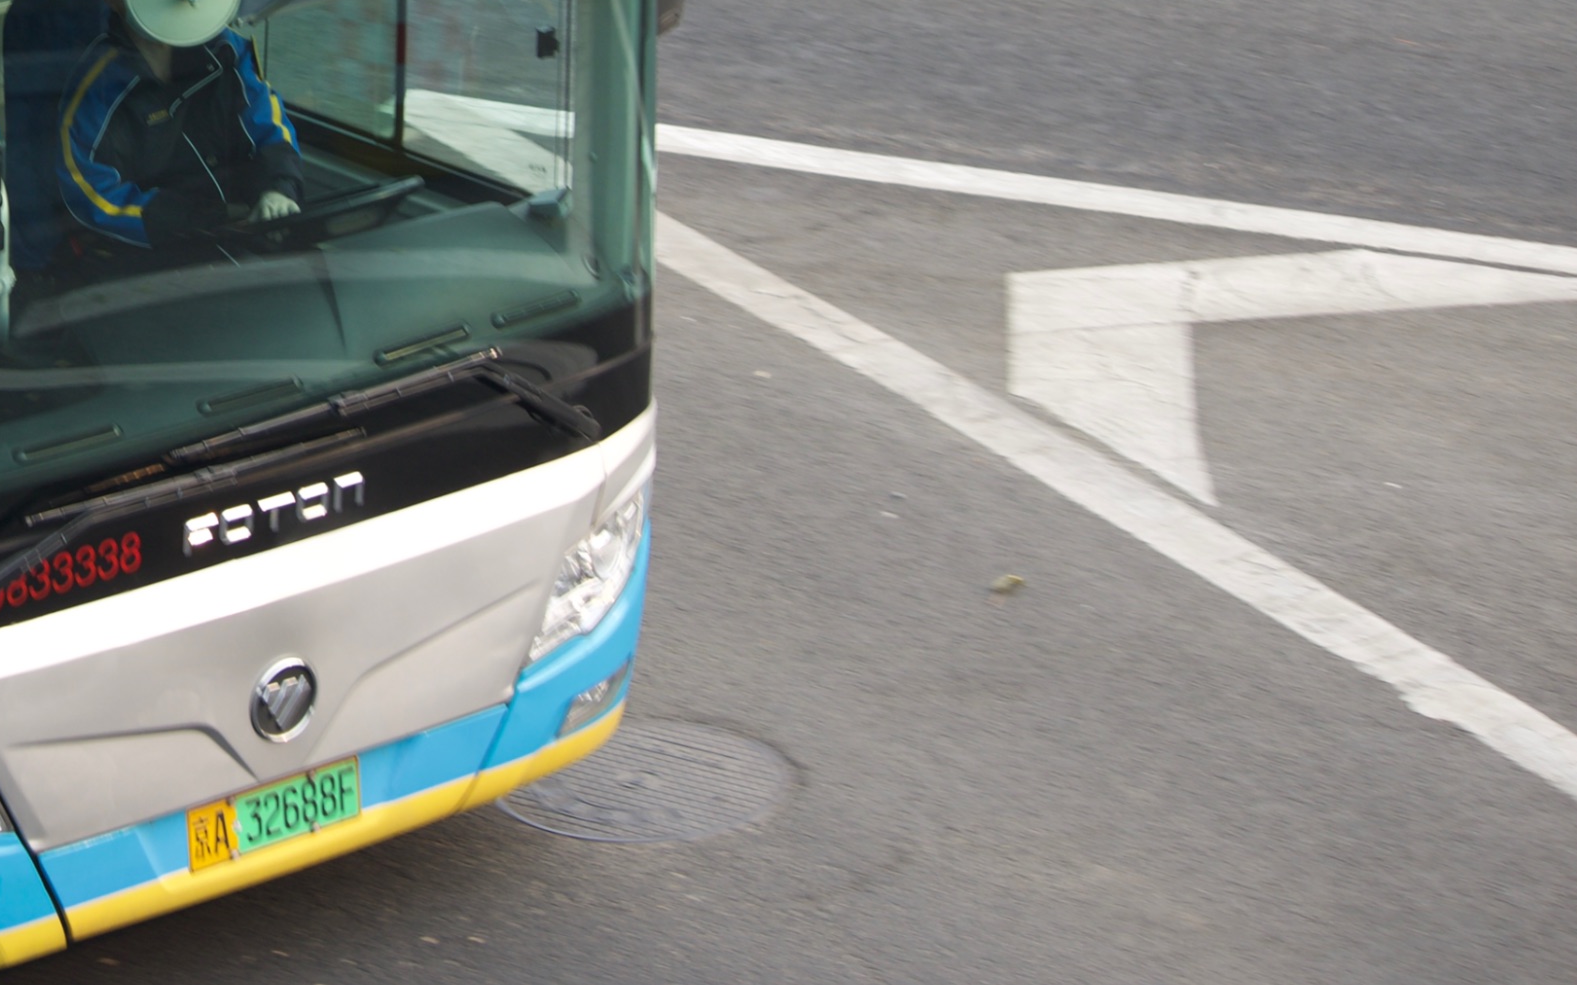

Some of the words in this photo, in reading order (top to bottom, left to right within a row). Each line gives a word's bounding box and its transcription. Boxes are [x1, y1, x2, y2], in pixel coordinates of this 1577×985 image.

[182, 471, 365, 557] FOTON
[192, 809, 231, 860] 京A
[245, 766, 355, 843] 32688F
